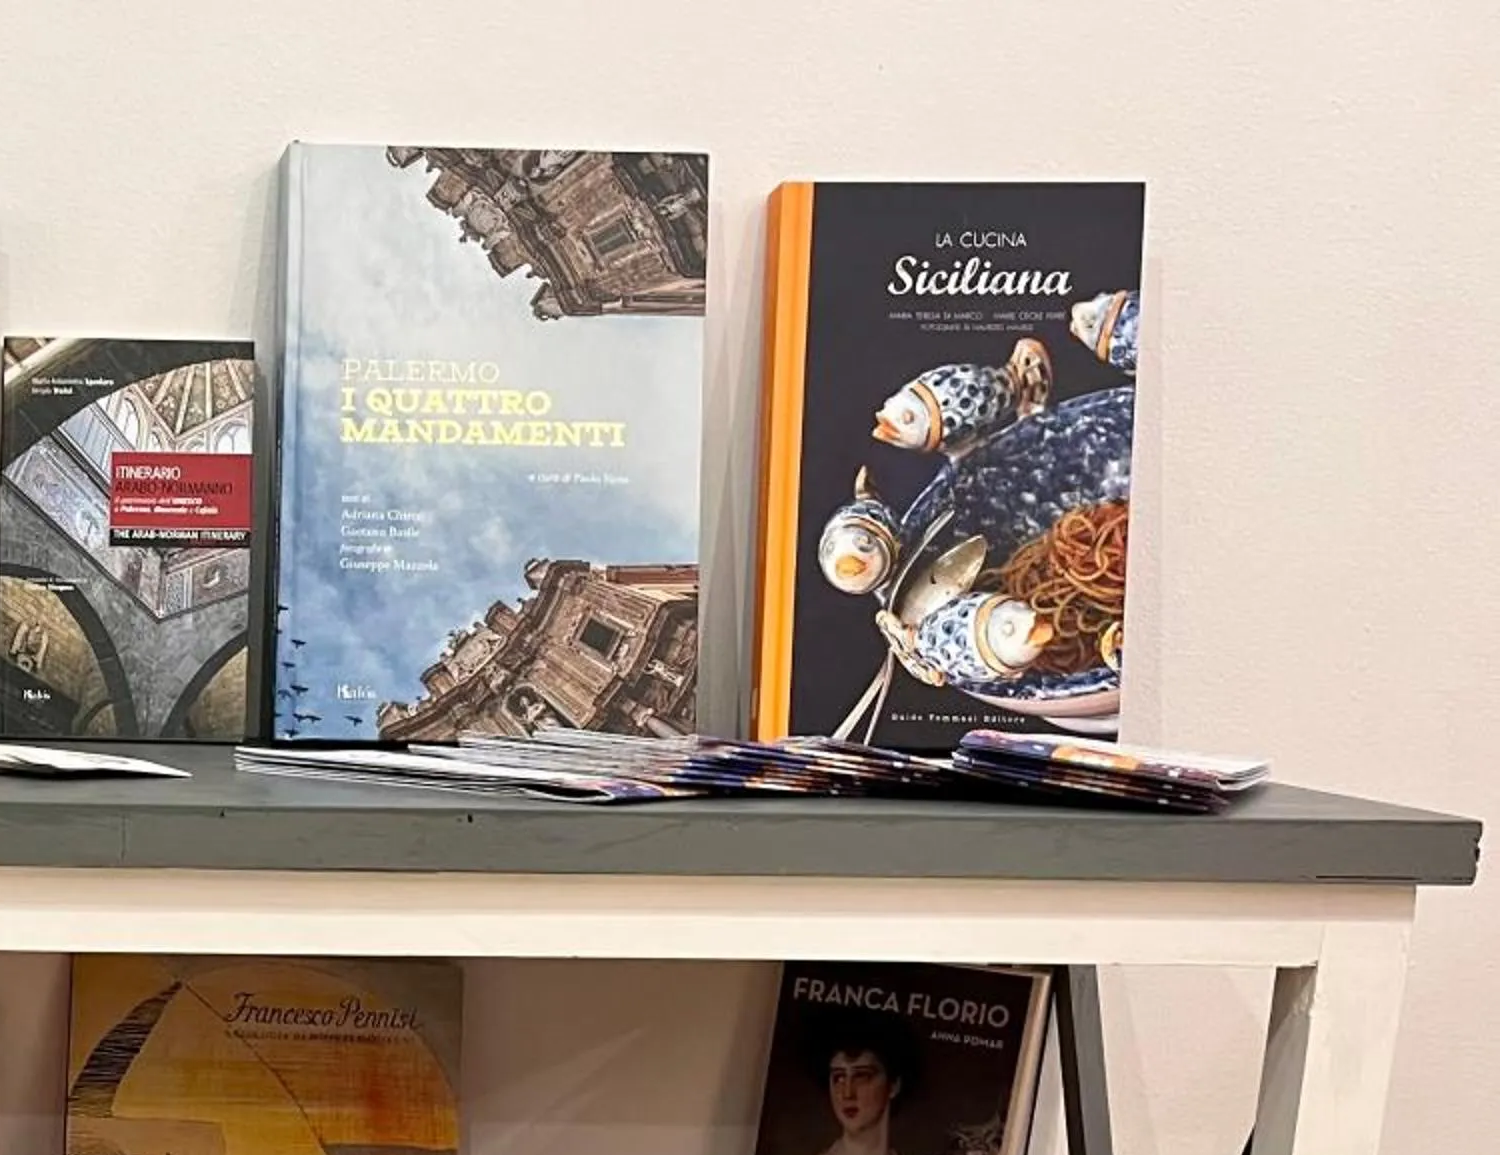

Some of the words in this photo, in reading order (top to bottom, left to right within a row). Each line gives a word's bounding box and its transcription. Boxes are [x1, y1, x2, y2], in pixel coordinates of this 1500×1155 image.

[935, 232, 953, 248] LA
[960, 231, 1027, 248] CUCINA
[887, 255, 1073, 296] Siciliana
[341, 358, 500, 384] PALERMO
[340, 387, 357, 412] I
[367, 388, 552, 416] QUATTRO
[340, 417, 626, 448] MANDAMENTI
[115, 465, 181, 480] ITINERARIO
[115, 481, 233, 495] ARABO-NORMANNO
[984, 714, 1026, 724] Editore
[226, 991, 334, 1026] Francesco
[334, 993, 424, 1030] Pennisi
[793, 976, 900, 1014] FRANCA
[907, 993, 1010, 1028] FLORIO
